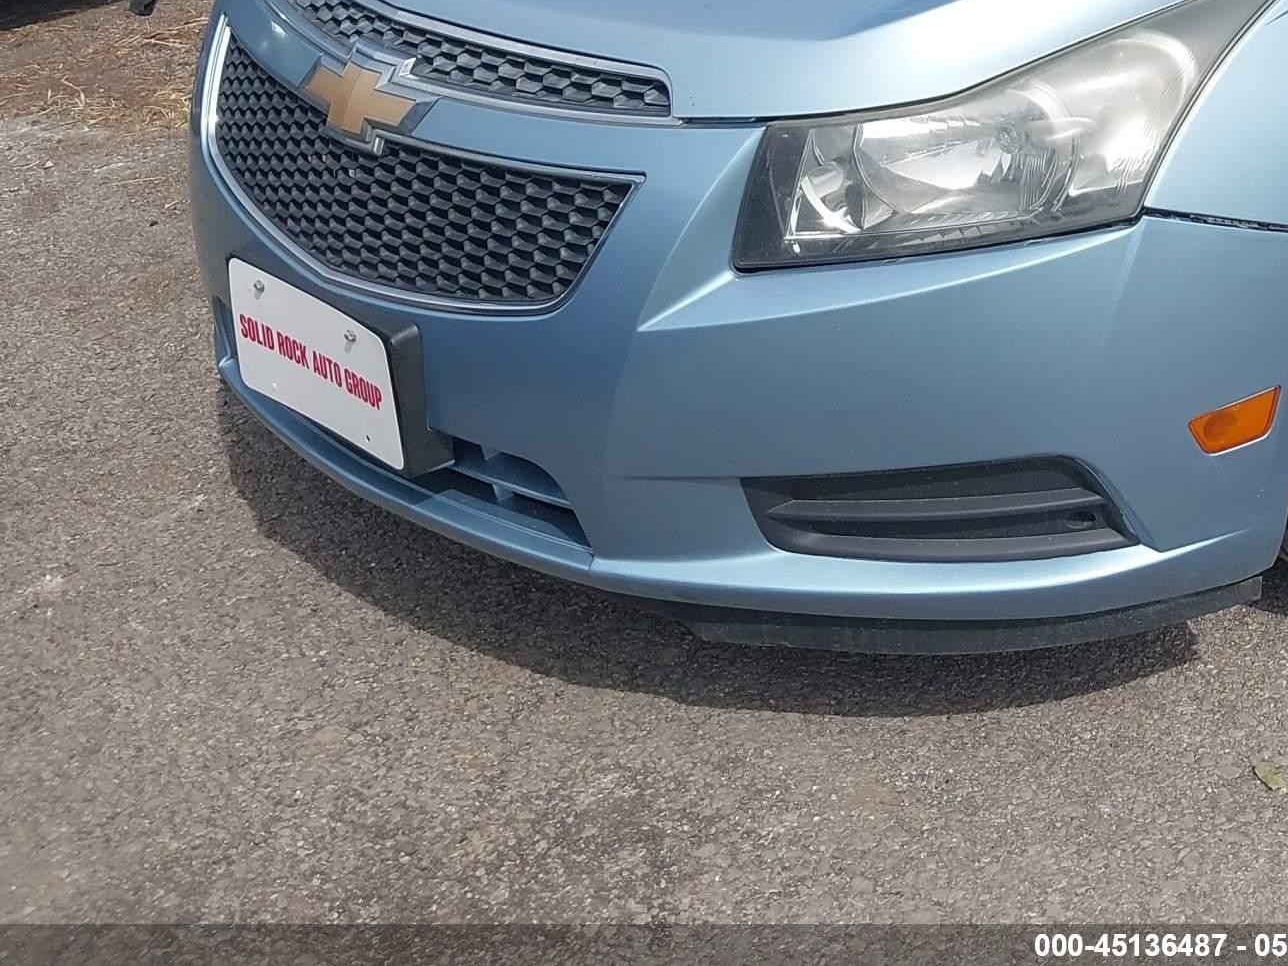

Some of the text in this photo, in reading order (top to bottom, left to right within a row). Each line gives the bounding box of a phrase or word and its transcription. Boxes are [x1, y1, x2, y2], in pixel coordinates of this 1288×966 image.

[239, 313, 383, 411] SOLID ROCK AUTO GROUP
